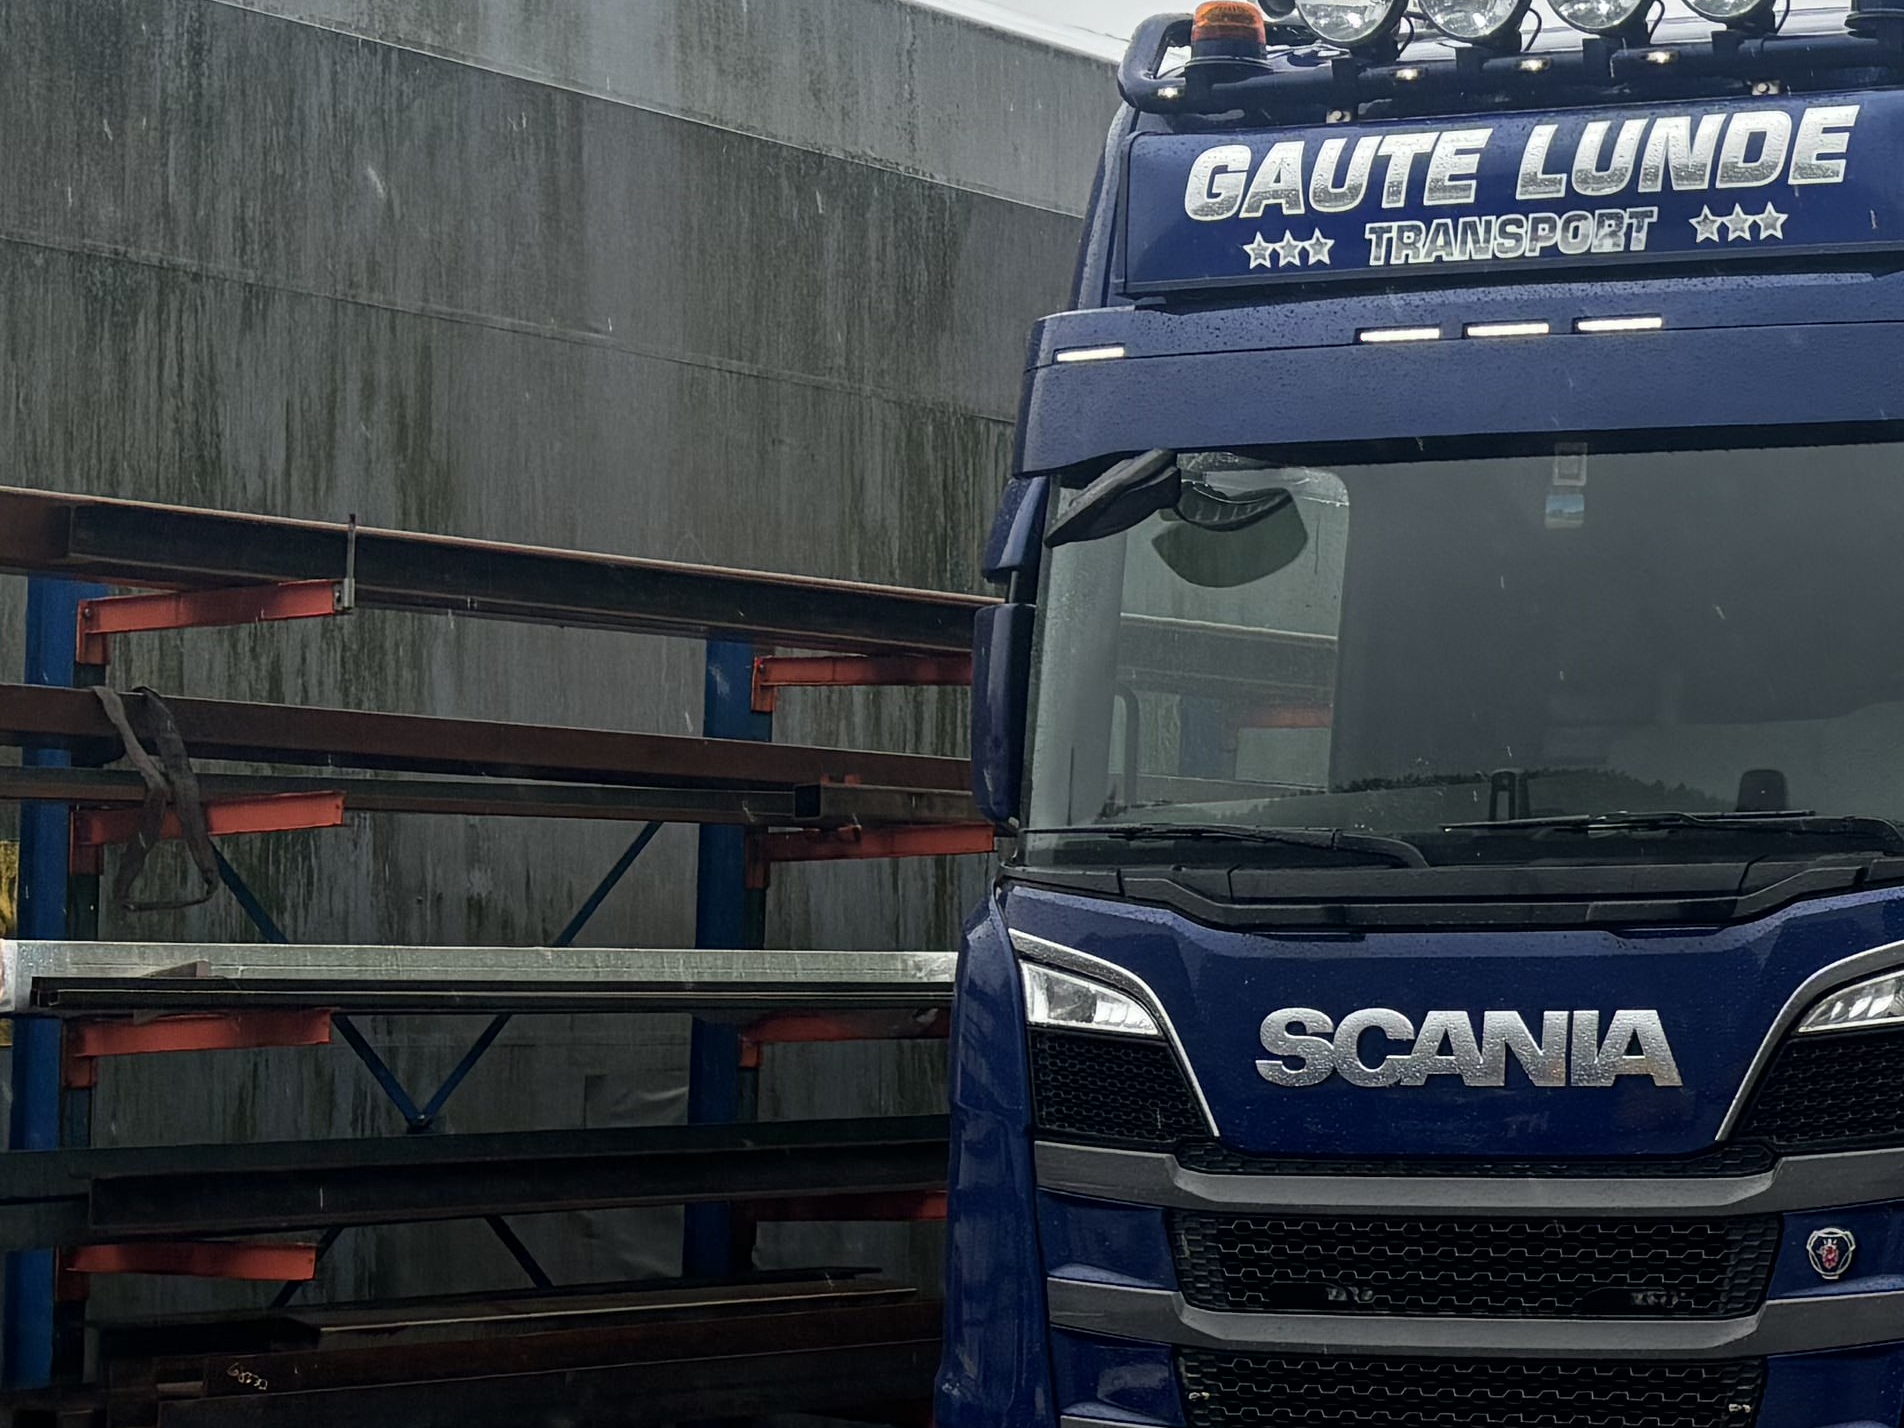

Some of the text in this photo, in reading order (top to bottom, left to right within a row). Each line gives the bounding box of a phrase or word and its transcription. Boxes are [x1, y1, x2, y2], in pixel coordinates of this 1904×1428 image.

[1183, 105, 1860, 221] GAUTE LUNDE
[1366, 207, 1658, 266] TRANSPORT
[1255, 1008, 1683, 1088] SCANIA
